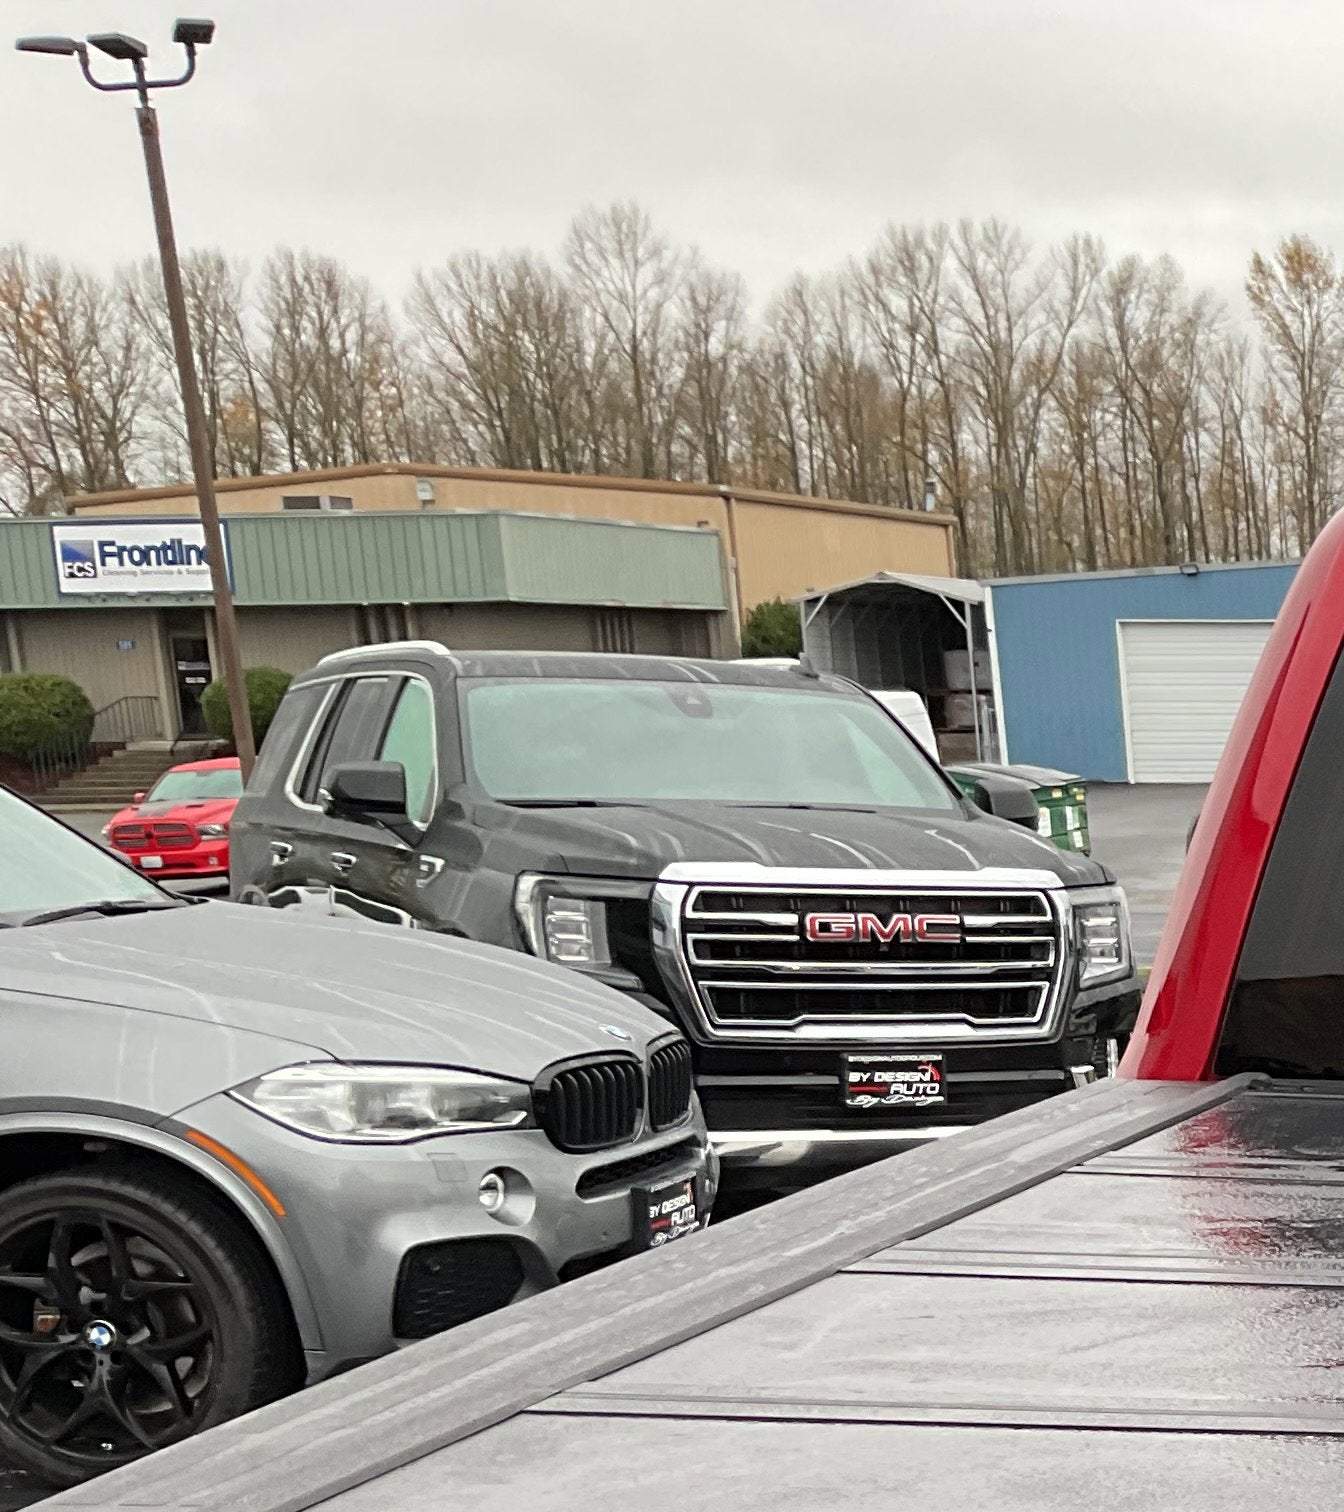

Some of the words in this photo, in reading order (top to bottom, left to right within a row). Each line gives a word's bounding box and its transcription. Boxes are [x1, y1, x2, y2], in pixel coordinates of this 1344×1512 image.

[64, 562, 95, 577] FCS
[805, 912, 961, 943] GMC
[848, 1071, 872, 1083] BY
[873, 1069, 932, 1083] DESIGN
[889, 1082, 940, 1095] AUTO
[671, 1204, 696, 1226] AUTO
